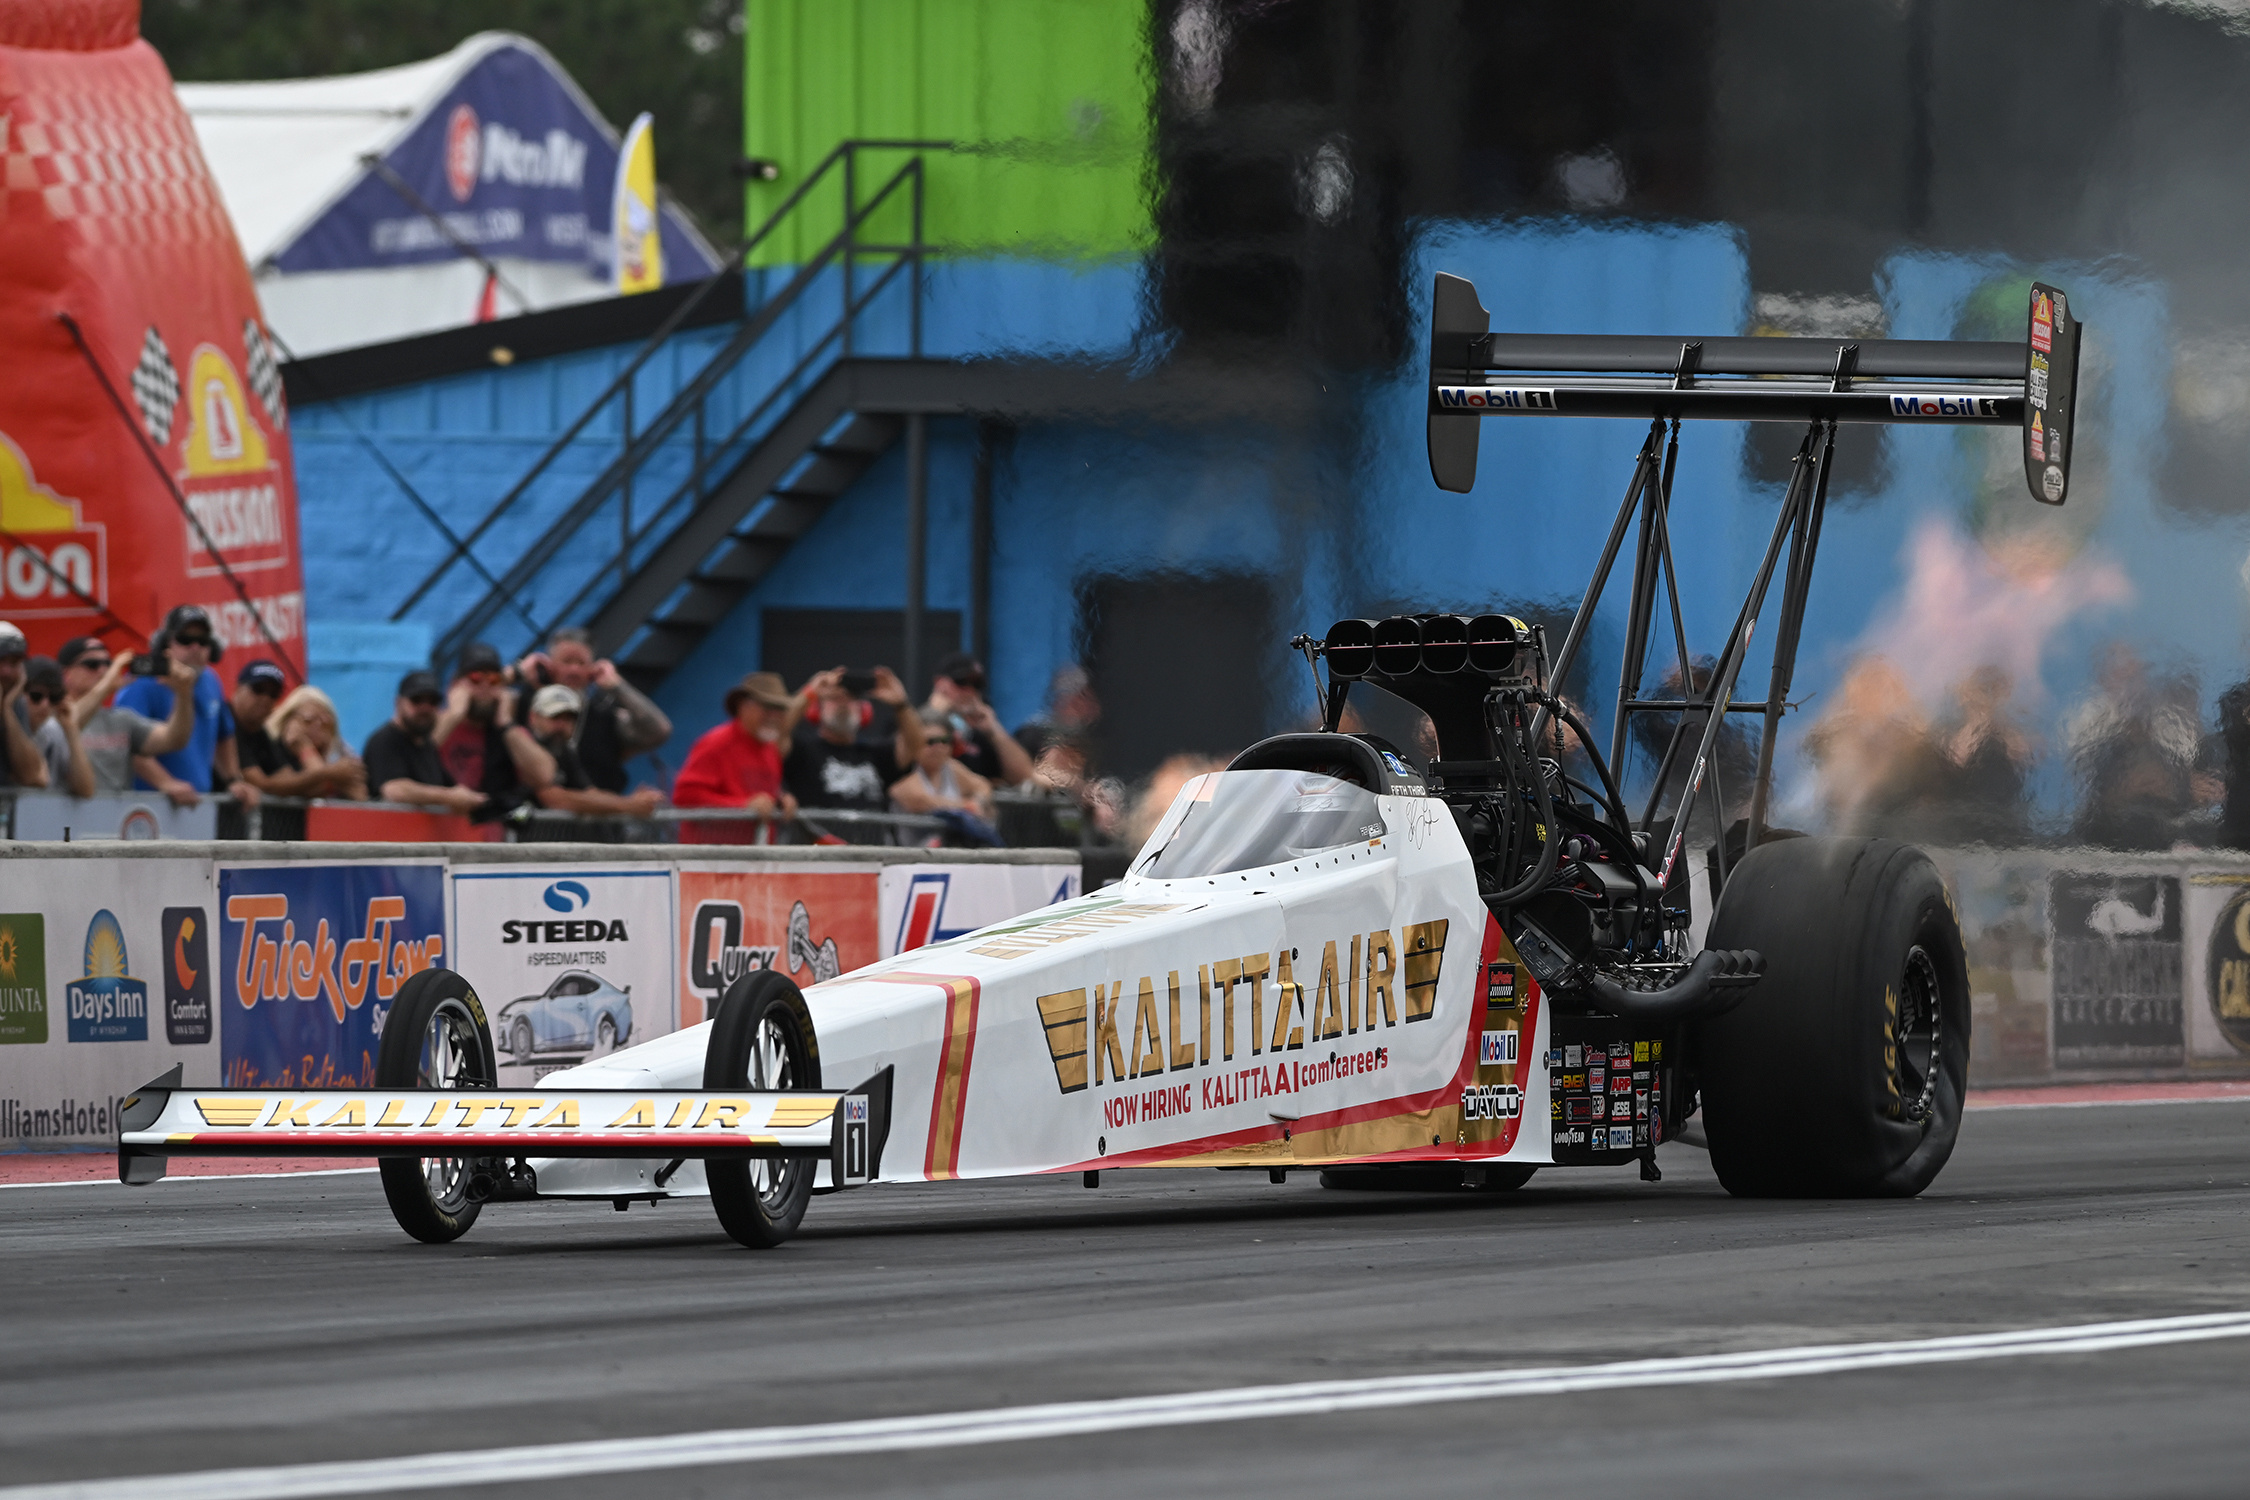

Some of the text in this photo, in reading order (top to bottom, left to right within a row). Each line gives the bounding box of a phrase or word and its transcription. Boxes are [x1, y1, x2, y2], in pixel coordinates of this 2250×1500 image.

[1441, 389, 1544, 408] Mobil 1
[1893, 397, 1998, 415] Mobil 1
[0, 542, 92, 598] on
[1391, 785, 1426, 796] FIFTH THIRD
[502, 919, 629, 943] STEEDA
[227, 893, 346, 1024] Trick
[528, 951, 607, 967] #SPEEDMATTERS
[0, 988, 43, 1020] UINTA
[71, 986, 143, 1023] Days Inn
[171, 999, 206, 1020] Comfort
[1094, 928, 1398, 1087] KALITTA AIR
[1481, 1034, 1516, 1061] Mobil 1
[1611, 1076, 1632, 1092] ARP
[263, 1098, 752, 1128] KALITTA AIR
[845, 1100, 867, 1121] Mobil
[1104, 1094, 1138, 1130] NOW
[1141, 1083, 1192, 1122] HIRING
[1463, 1084, 1521, 1121] DAYCO
[1611, 1101, 1631, 1117] JESEL
[1554, 1127, 1585, 1147] GOODYEAR
[1610, 1130, 1631, 1146] MAHLE
[851, 1126, 860, 1173] 1
